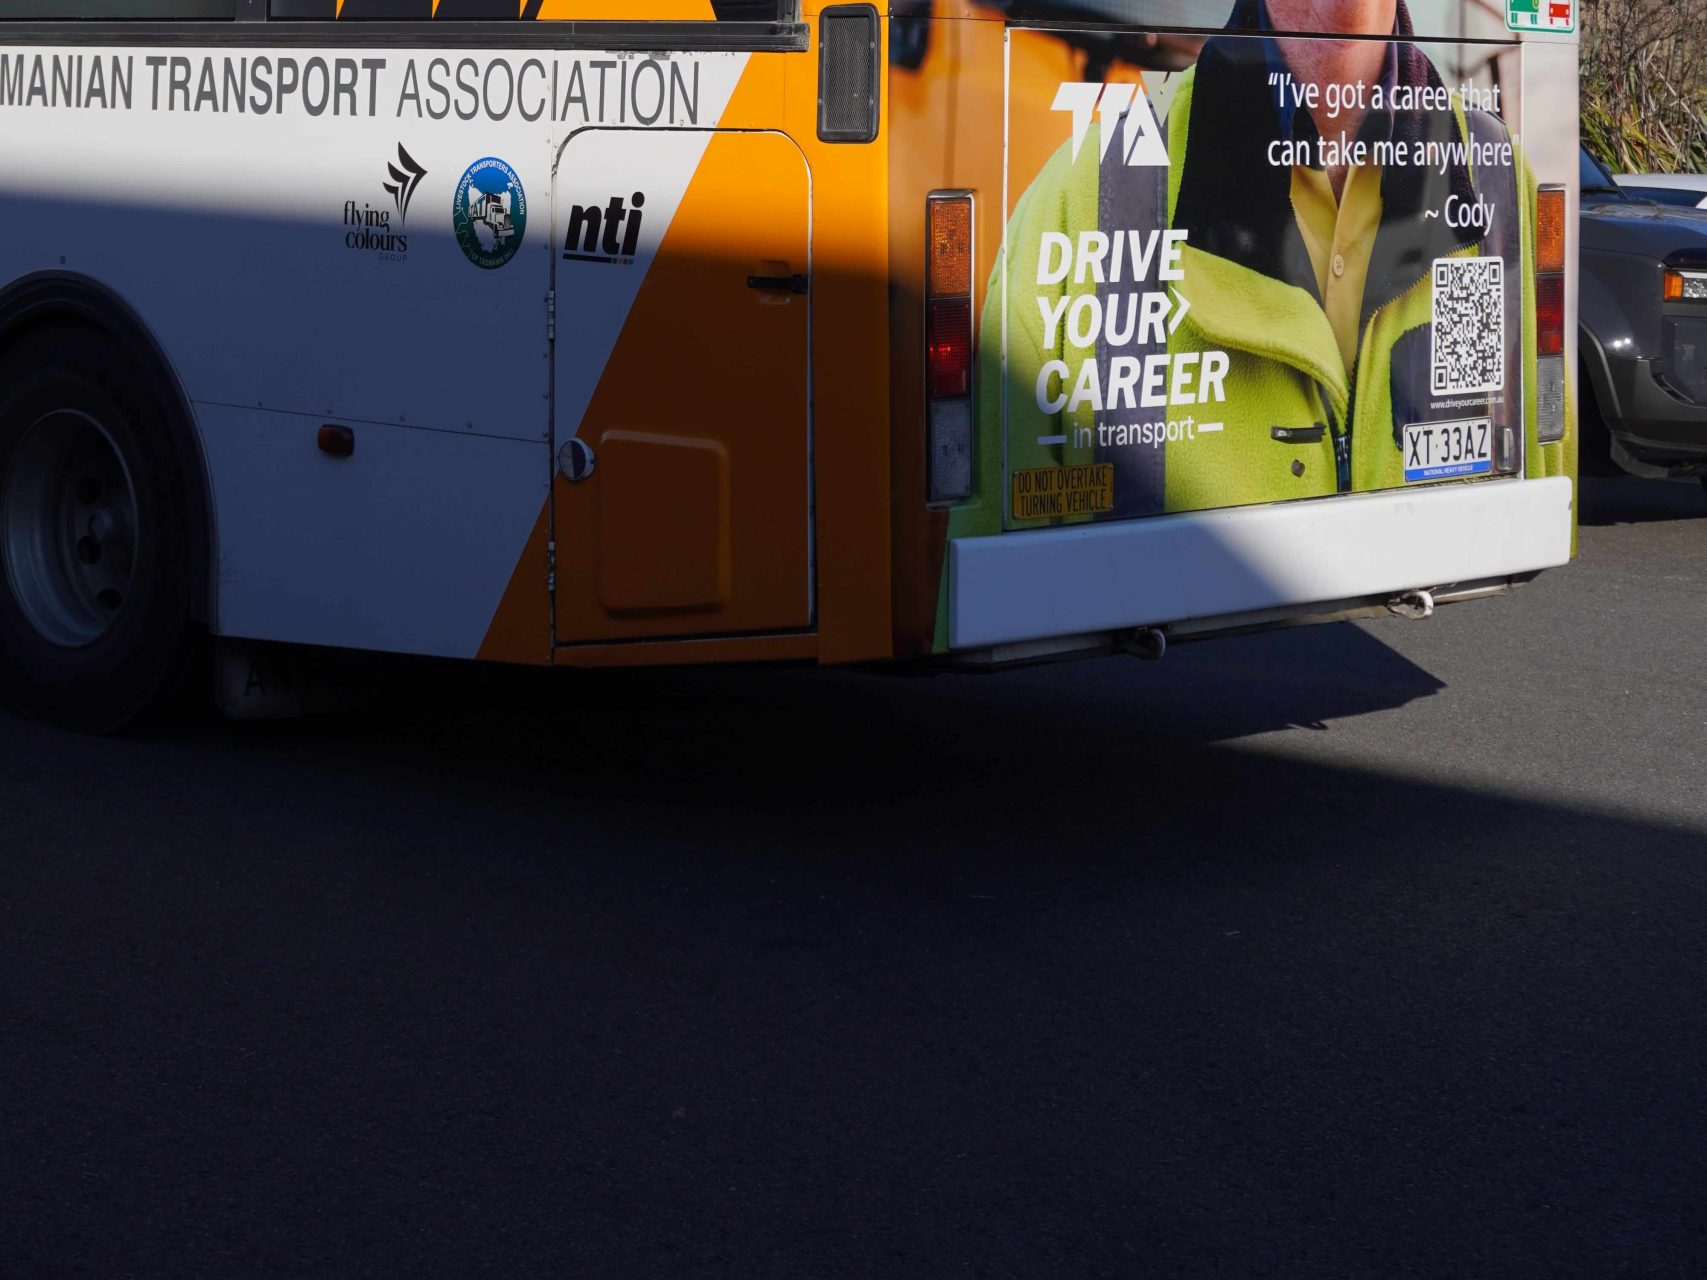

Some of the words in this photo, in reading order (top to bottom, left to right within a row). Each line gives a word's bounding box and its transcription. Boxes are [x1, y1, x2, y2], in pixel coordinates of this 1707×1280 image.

[145, 55, 387, 117] TRANSPORT
[396, 57, 700, 126] ASSOCIATION
[1267, 72, 1320, 110] “I’ve
[1326, 80, 1366, 118] got
[1371, 84, 1384, 110] a
[1390, 83, 1453, 111] career
[1460, 77, 1501, 113] that
[1267, 140, 1310, 167] can
[1317, 130, 1367, 167] take
[1373, 140, 1408, 167] me
[1413, 130, 1520, 175] anywhere”
[455, 175, 472, 209] LIVESTOCK
[471, 160, 508, 174] TRANSPORTERS
[508, 172, 525, 214] ASSOCIATION
[344, 200, 390, 233] flying
[563, 191, 645, 256] nti
[1444, 193, 1496, 237] Cody
[345, 228, 408, 253] colours
[1036, 229, 1189, 286] DRIVE
[1036, 350, 1230, 415] CAREER
[1430, 396, 1505, 410] www.driveyourcareer.com.au
[1073, 421, 1092, 449] in
[1097, 415, 1195, 447] transport
[1018, 472, 1032, 493] DO
[1034, 470, 1054, 492] NOT
[1057, 466, 1107, 490] OVERTAKE
[1423, 468, 1444, 476] NATIONAL
[1445, 466, 1457, 474] HEAVY
[1458, 464, 1473, 473] VEHICLE
[1020, 492, 1062, 517] TURNING
[1066, 488, 1107, 512] VEHICLE
